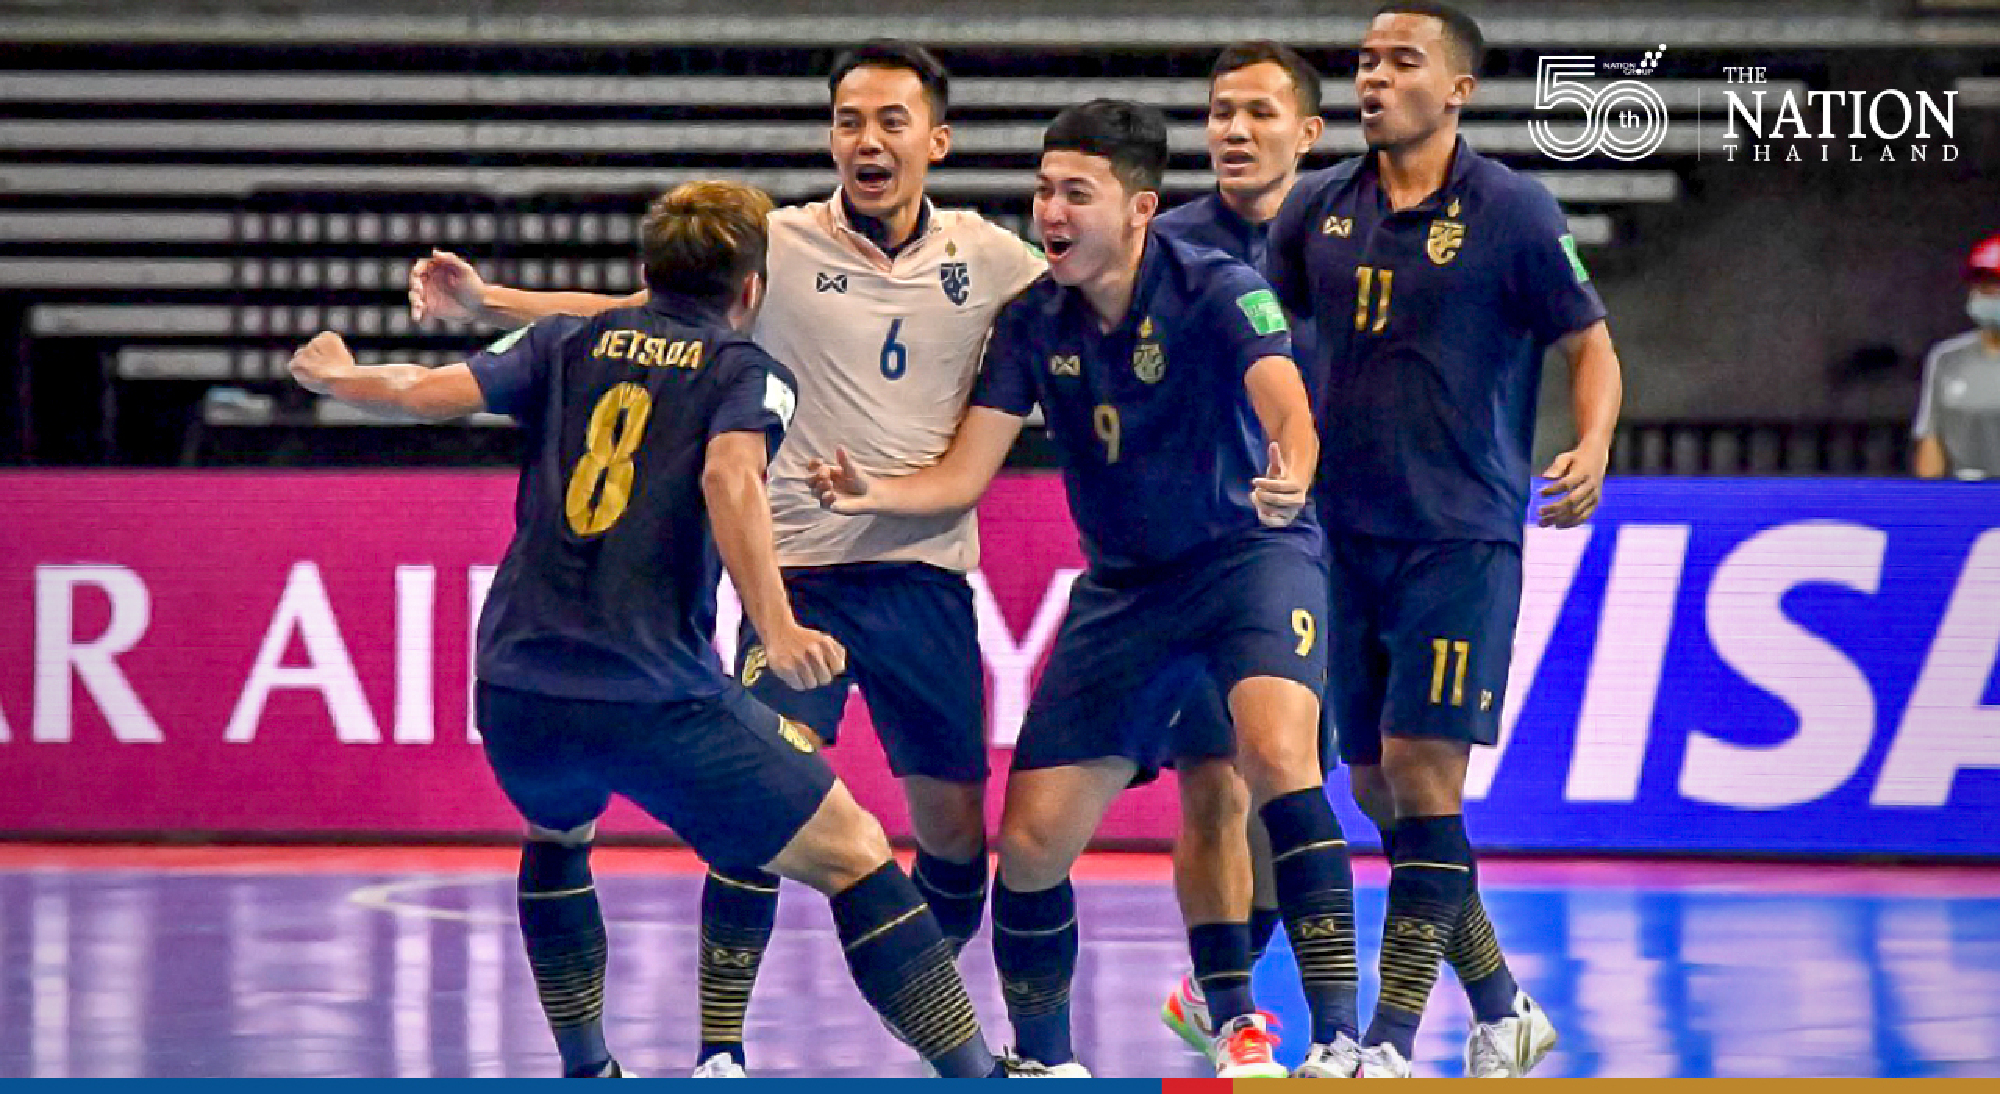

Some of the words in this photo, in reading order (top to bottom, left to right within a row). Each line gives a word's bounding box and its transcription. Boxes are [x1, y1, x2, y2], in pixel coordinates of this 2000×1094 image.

[1354, 265, 1394, 335] 11
[879, 316, 909, 382] 6
[565, 382, 652, 537] 8
[1094, 403, 1122, 465] 9
[0, 562, 166, 744] R
[1291, 607, 1317, 657] 9
[1430, 637, 1470, 706] 11
